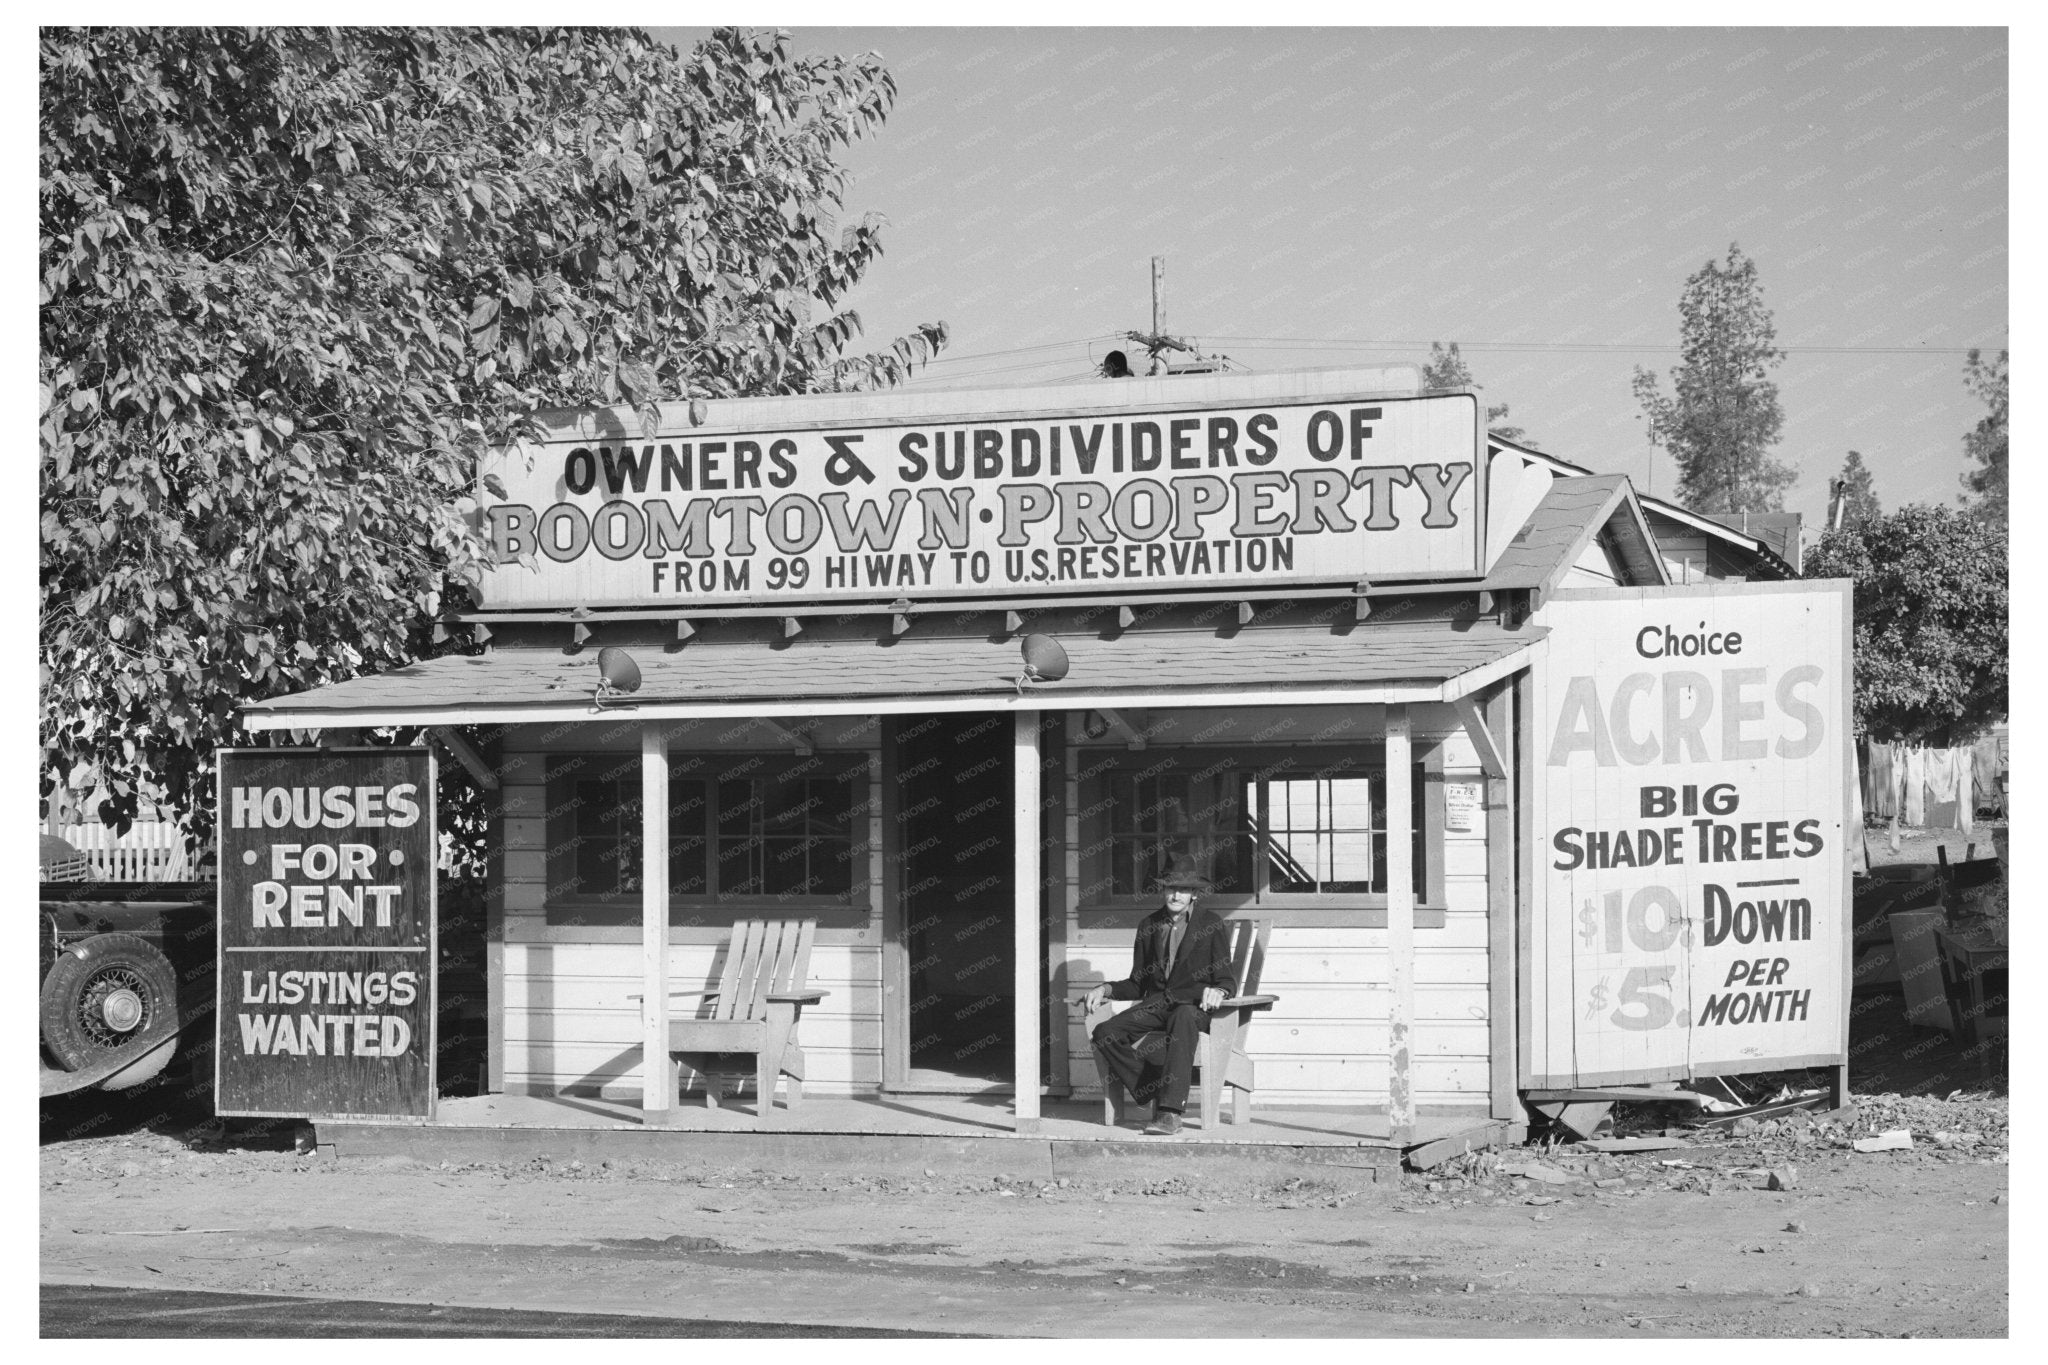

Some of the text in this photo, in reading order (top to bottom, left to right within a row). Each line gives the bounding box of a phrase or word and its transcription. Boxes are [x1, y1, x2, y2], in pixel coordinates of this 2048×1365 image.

[564, 407, 1383, 495] OWNERS & SUBDIVIDERS OF
[997, 462, 1473, 547] PROPERTY
[652, 558, 751, 593] FROM
[765, 557, 810, 590] 99
[825, 551, 937, 588] HIWAY
[949, 550, 990, 584] TO
[1635, 620, 1743, 659] Choice
[1547, 666, 1825, 768] ACRES
[231, 783, 420, 829] HOUSES
[1640, 783, 1740, 818] BIG
[271, 843, 377, 880] FOR
[1553, 818, 1824, 871] SHADE TREES
[252, 881, 401, 928] RENT
[1703, 883, 1812, 947] Down
[242, 970, 417, 1006] LISTINGS
[1723, 957, 1790, 988] PER
[1697, 988, 1811, 1027] MONTH
[238, 1013, 411, 1057] WANTED
